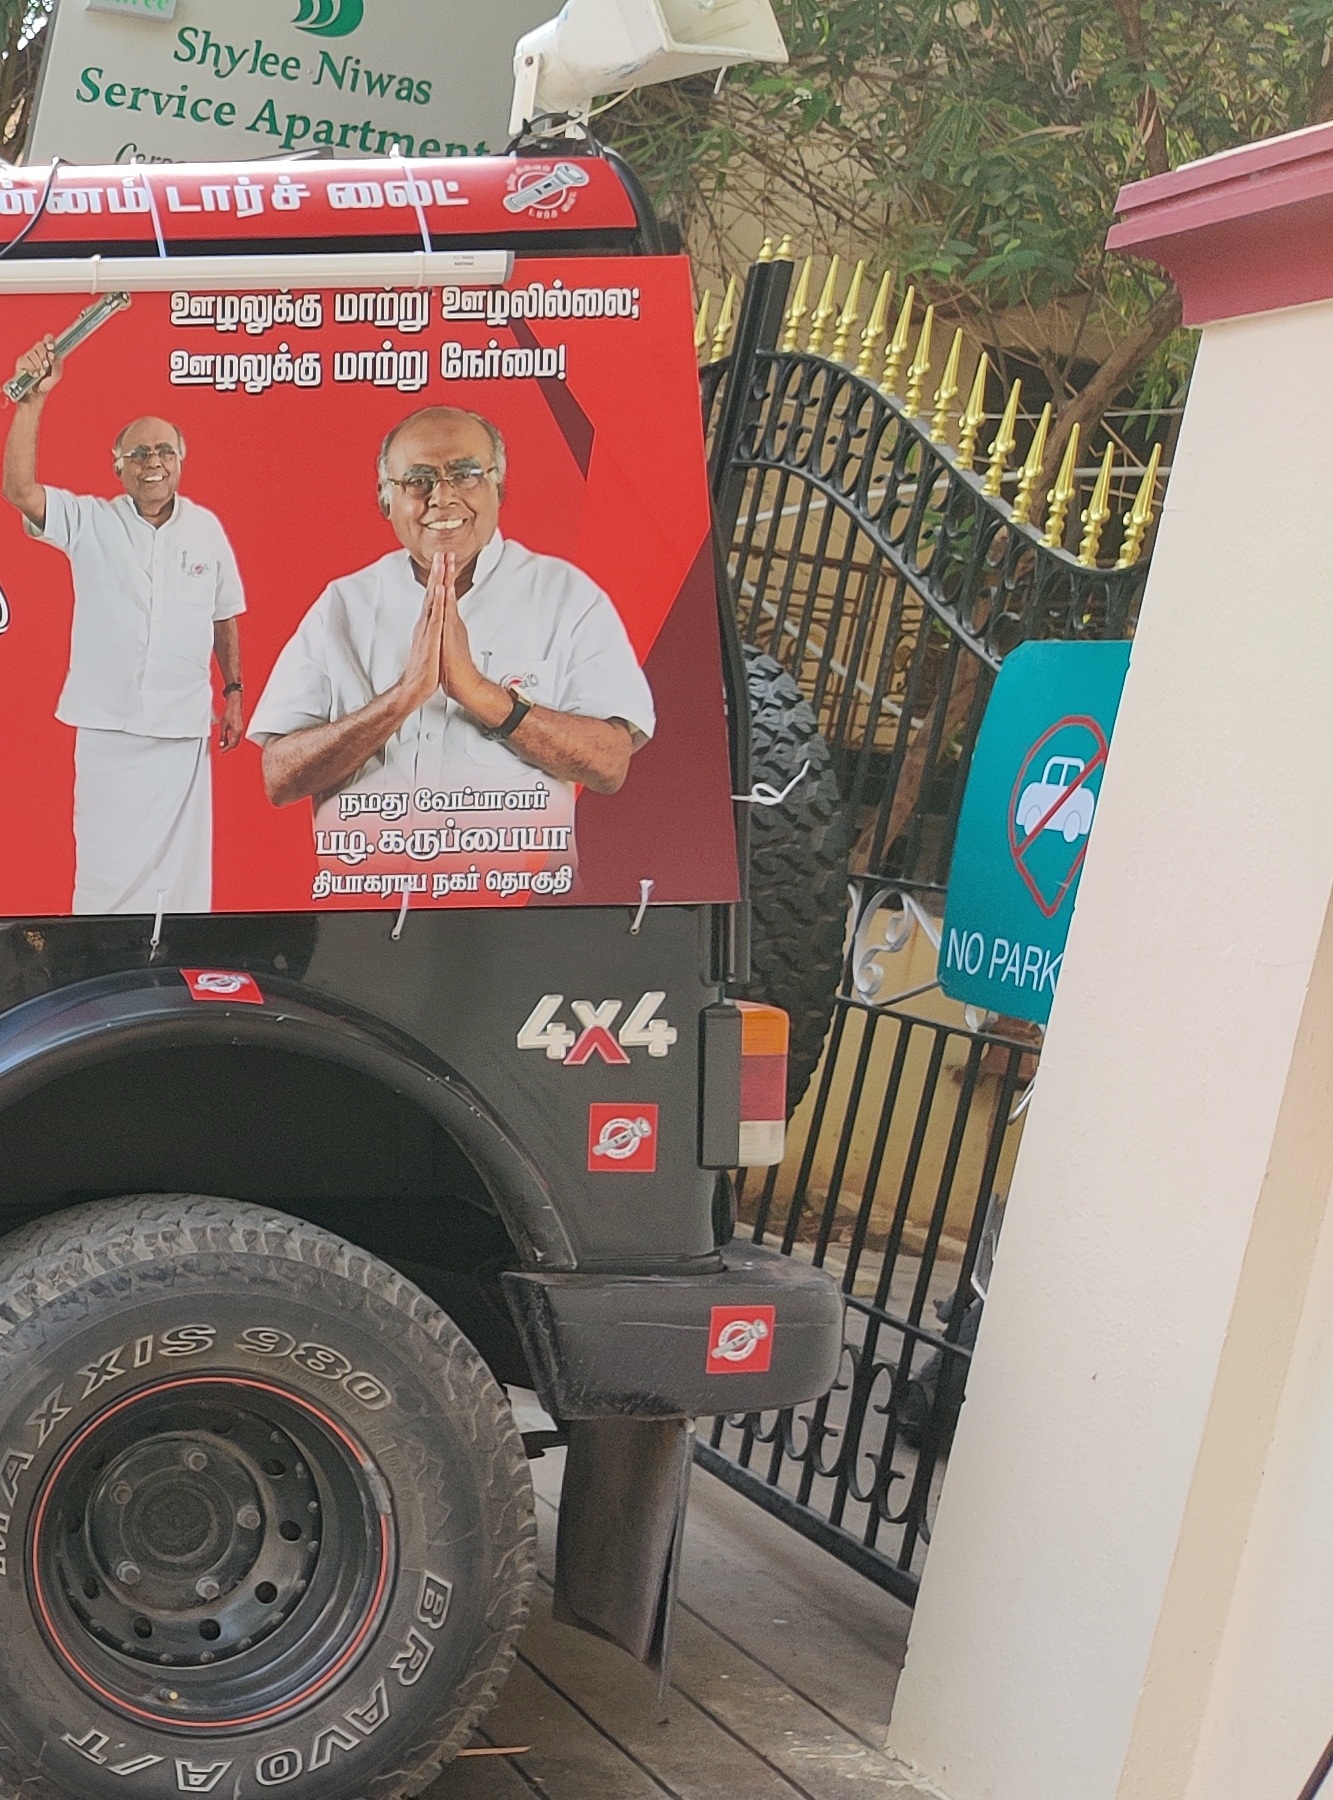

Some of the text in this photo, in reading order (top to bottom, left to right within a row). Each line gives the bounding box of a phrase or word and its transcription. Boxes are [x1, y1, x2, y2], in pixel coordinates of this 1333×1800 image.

[173, 26, 432, 105] Shylee Niwas
[76, 66, 236, 127] Service
[166, 176, 310, 219] டார்ச்
[326, 179, 469, 210] லைட்
[169, 279, 641, 334] ஊழலுக்கு மாற்று ஊழலில்லை;
[169, 339, 567, 393] ஊழலுக்கு மாற்று நேர்மை!
[339, 782, 549, 819] நமது வேட்பாளர்
[312, 865, 573, 899] தியாகராய நகர் தொகுதி
[945, 928, 984, 976] NO
[236, 1326, 393, 1412] 980
[59, 1569, 454, 1794] BRAVO A/T
